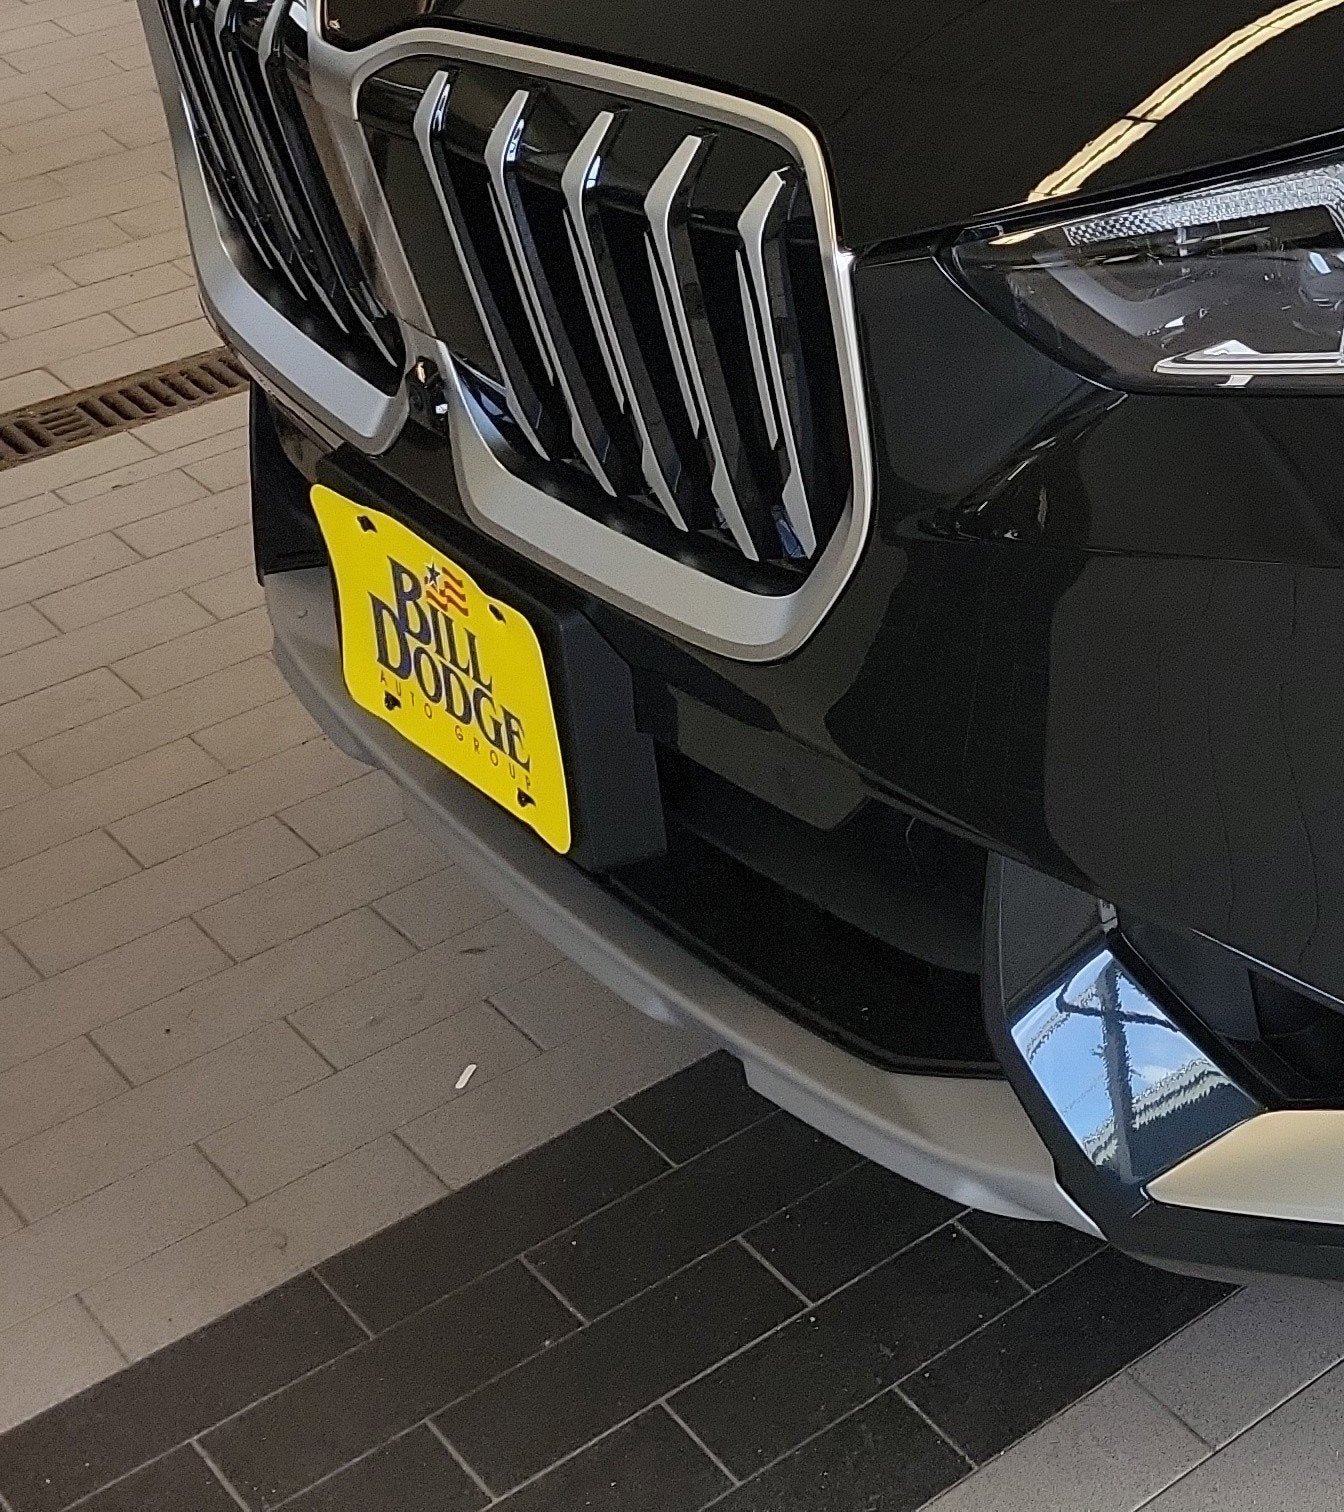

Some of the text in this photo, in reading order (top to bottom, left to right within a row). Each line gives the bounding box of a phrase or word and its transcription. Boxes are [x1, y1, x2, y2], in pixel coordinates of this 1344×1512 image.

[367, 590, 531, 773] DODGE
[386, 555, 493, 696] BILL
[380, 669, 532, 788] AUTO GROUP
